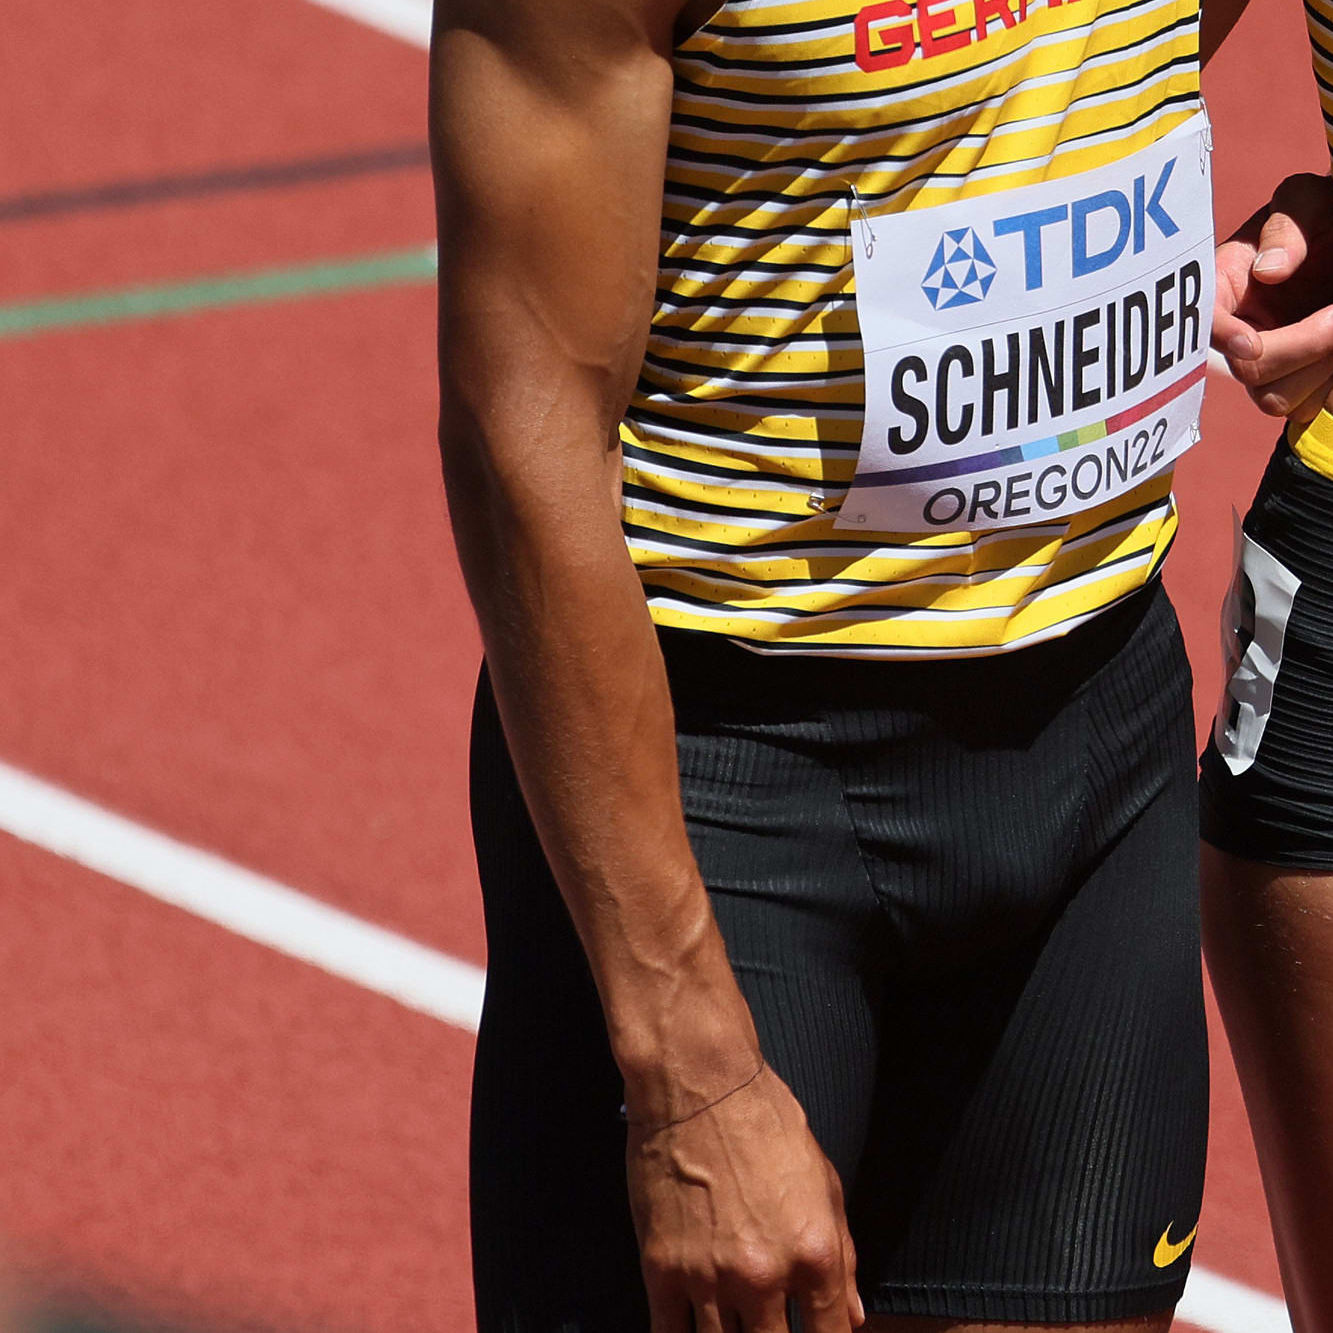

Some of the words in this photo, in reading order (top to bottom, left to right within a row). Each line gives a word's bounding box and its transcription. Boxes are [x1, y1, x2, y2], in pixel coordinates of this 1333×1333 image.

[993, 155, 1181, 292] TDK
[886, 258, 1202, 456] SCHNEIDER
[922, 417, 1169, 527] OREGON22
